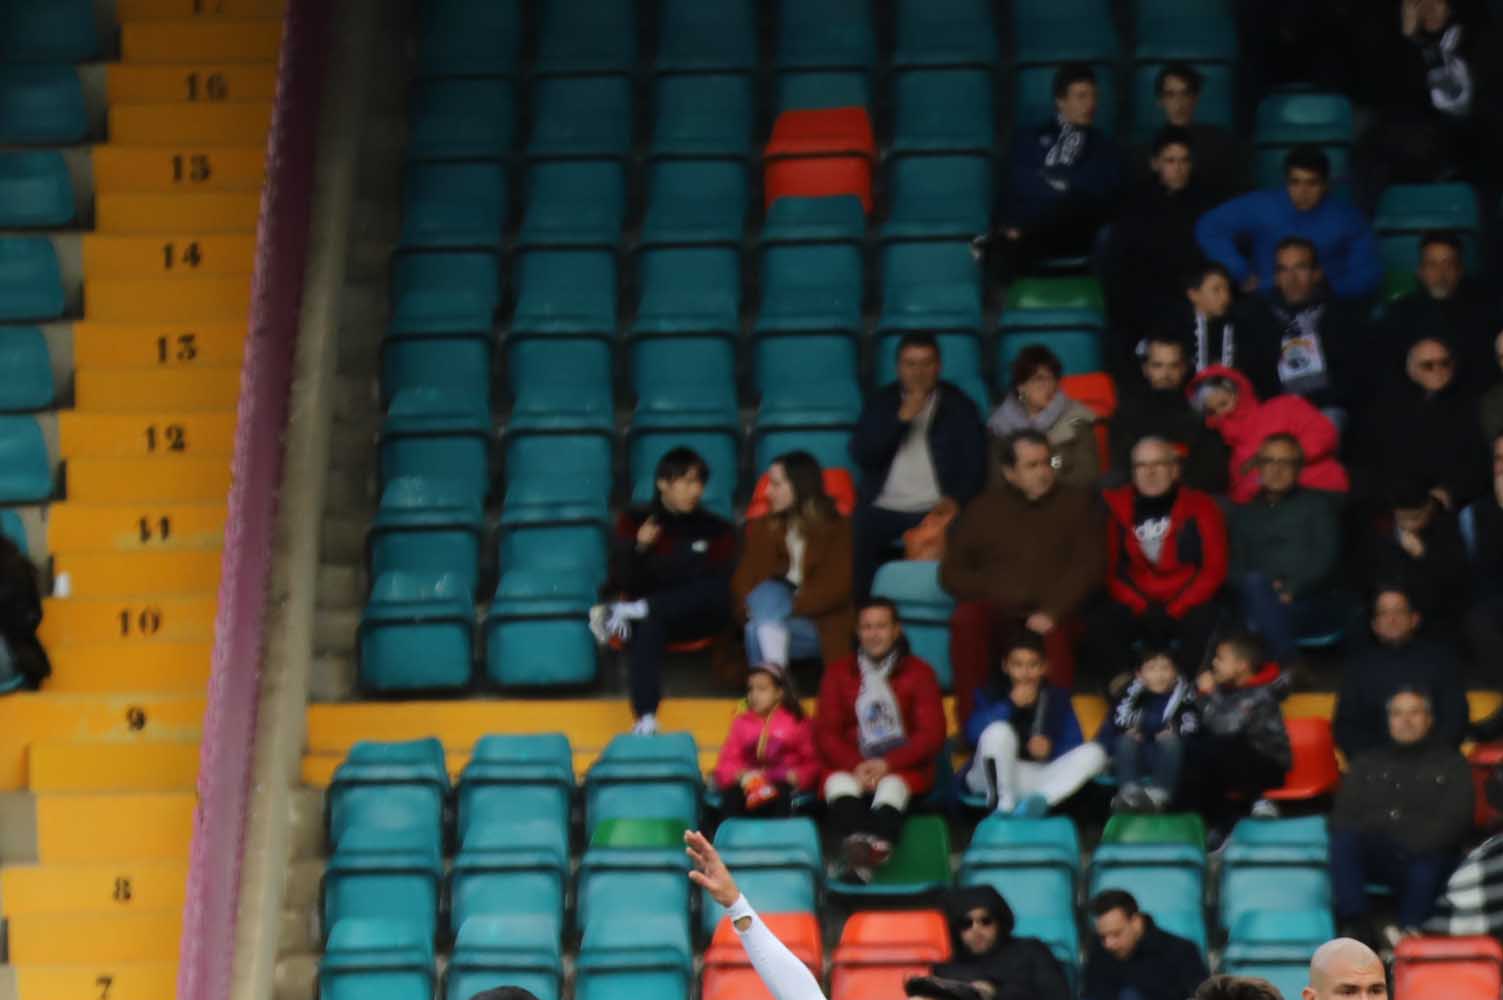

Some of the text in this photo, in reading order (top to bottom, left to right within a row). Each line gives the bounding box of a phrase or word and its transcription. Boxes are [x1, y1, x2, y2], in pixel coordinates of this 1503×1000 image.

[186, 73, 228, 103] 16
[163, 242, 202, 270] 14
[157, 333, 198, 364] 13
[145, 425, 186, 453] 12
[139, 515, 171, 542] 11
[119, 607, 162, 637] 10
[127, 706, 146, 731] 9
[112, 876, 132, 902] 8
